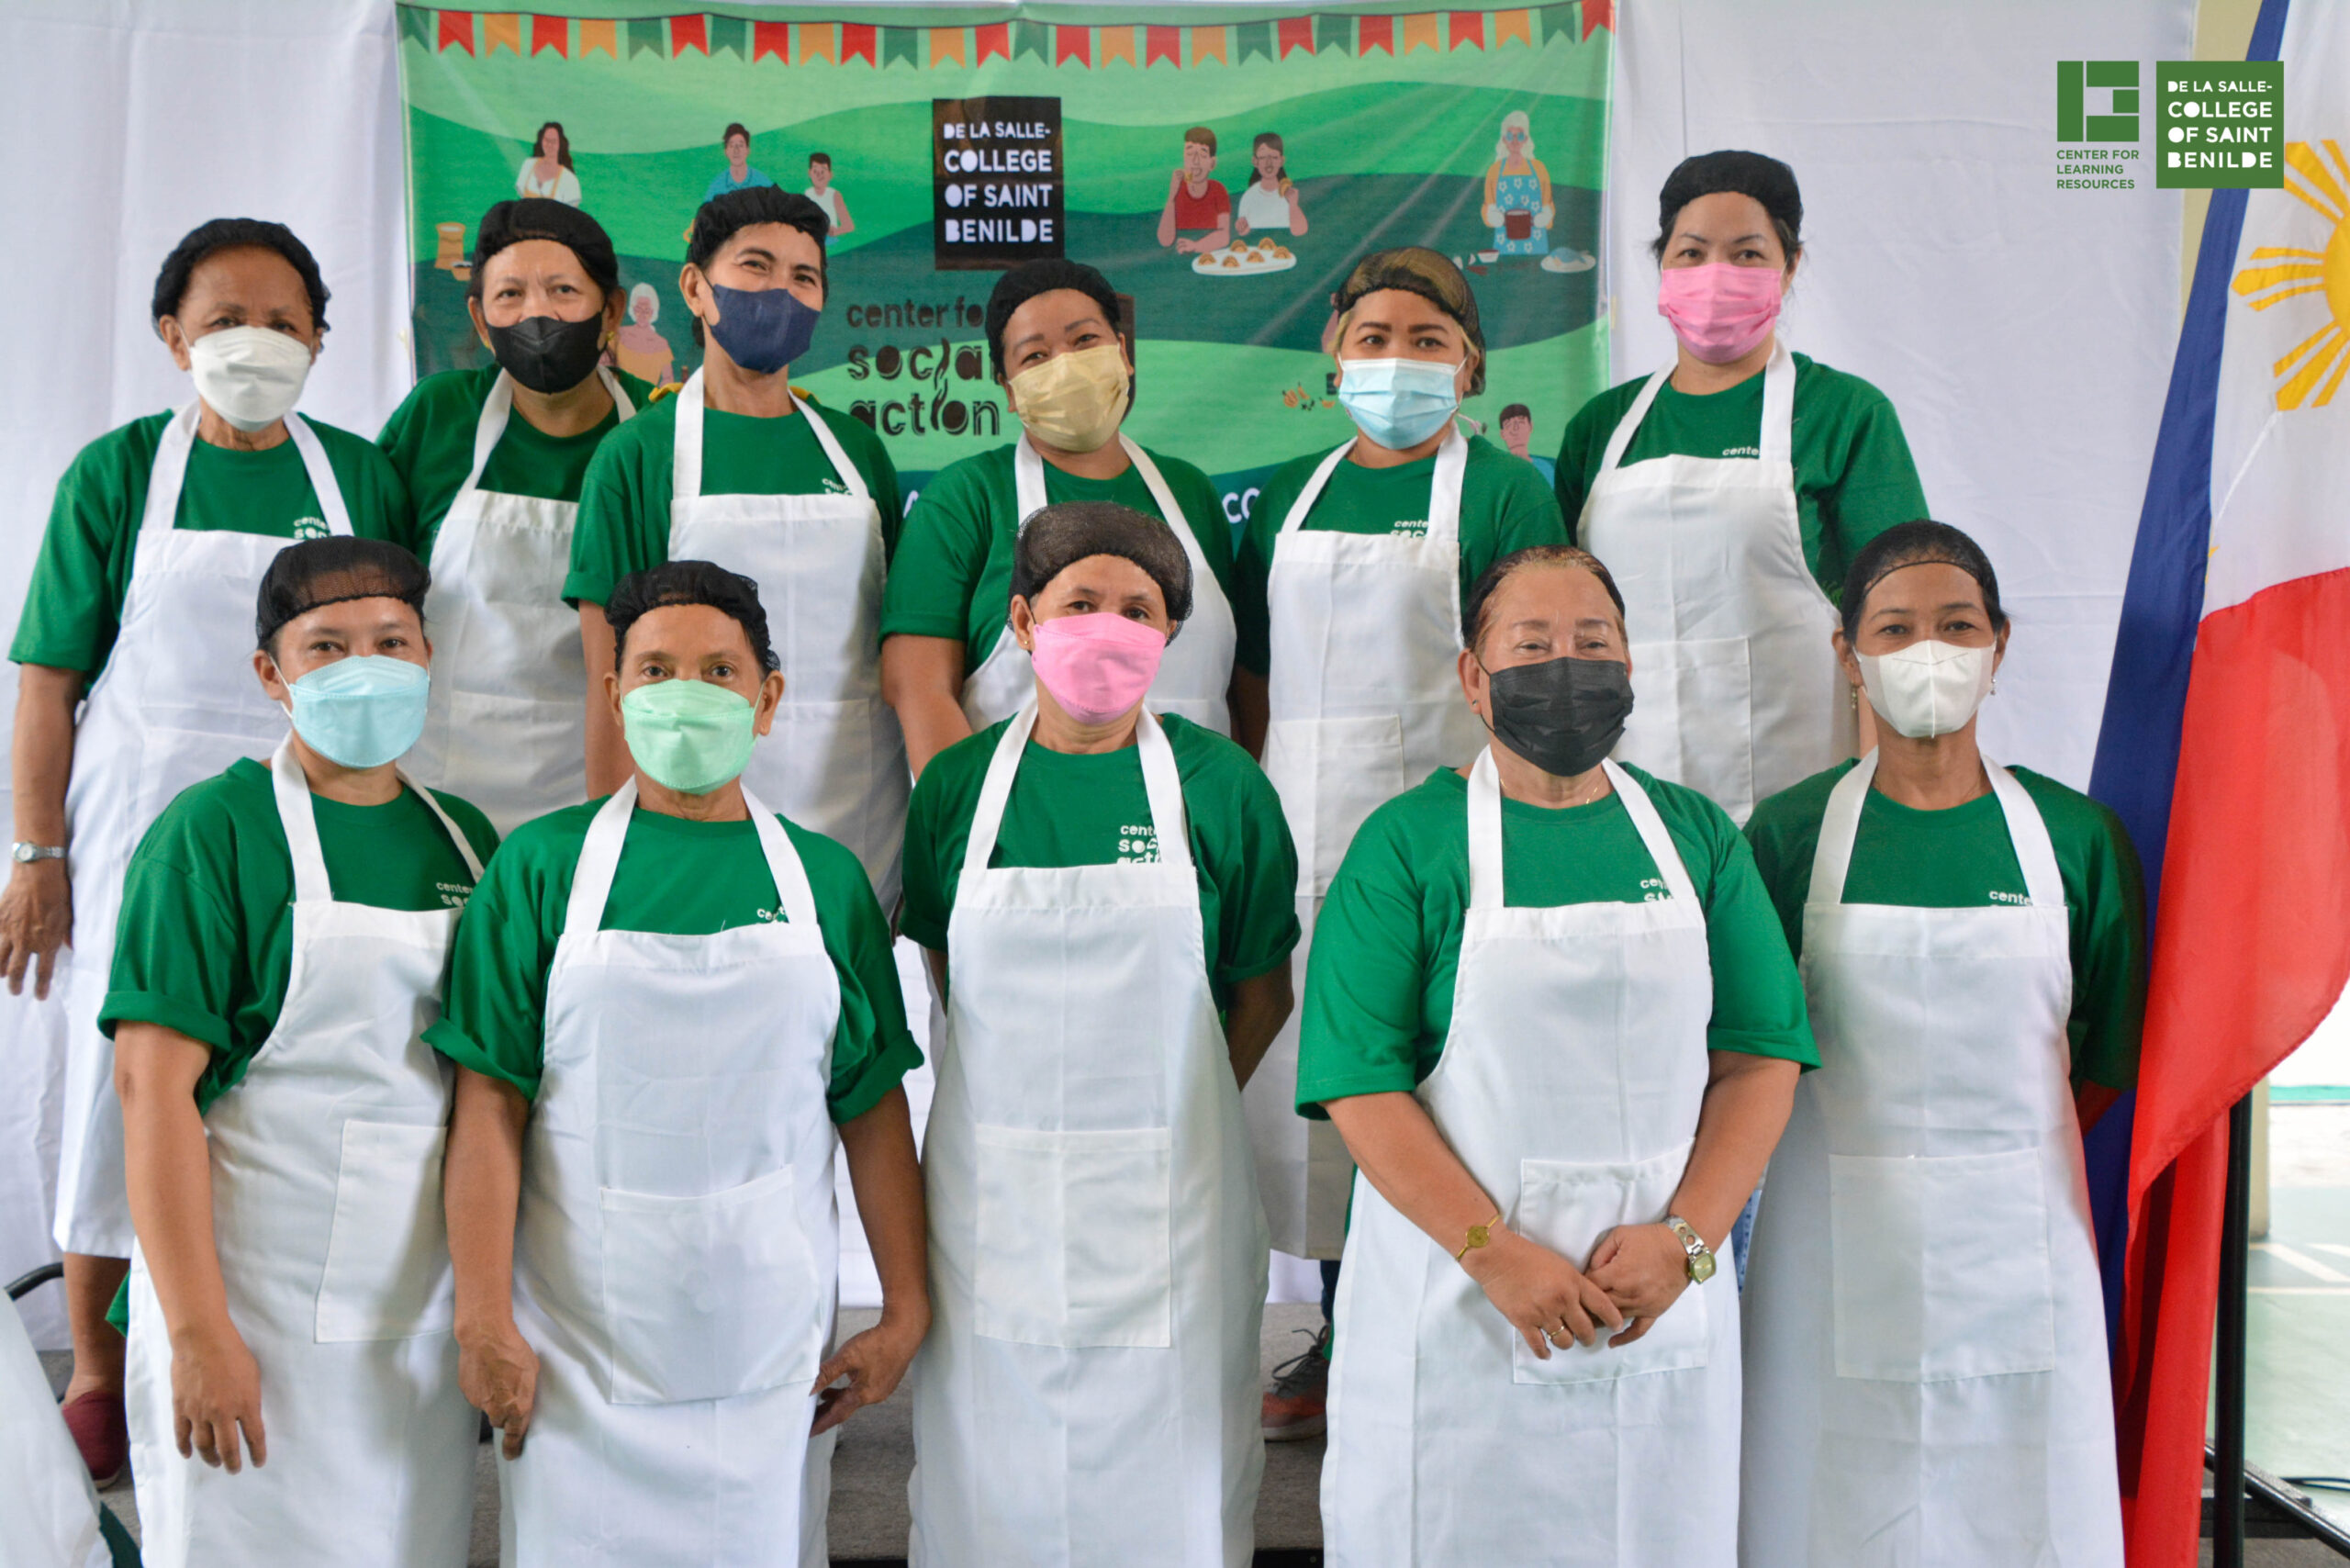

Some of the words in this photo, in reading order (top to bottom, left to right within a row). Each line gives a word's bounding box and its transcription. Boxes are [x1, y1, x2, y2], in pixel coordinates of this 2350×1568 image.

[943, 122, 966, 140] DE
[969, 121, 991, 139] LA
[994, 121, 1051, 140] SALLE-
[944, 149, 1053, 174] COLLEGE
[945, 184, 978, 208] OF
[983, 184, 1054, 208] SAINT
[945, 218, 1054, 243] BENILDE
[846, 298, 949, 329] center
[955, 296, 985, 328] fo
[849, 378, 1001, 436] action
[1721, 445, 1761, 456] cente
[293, 517, 329, 530] cente
[1393, 520, 1429, 529] cente
[1120, 824, 1158, 836] cent
[1988, 890, 2033, 906] cente
